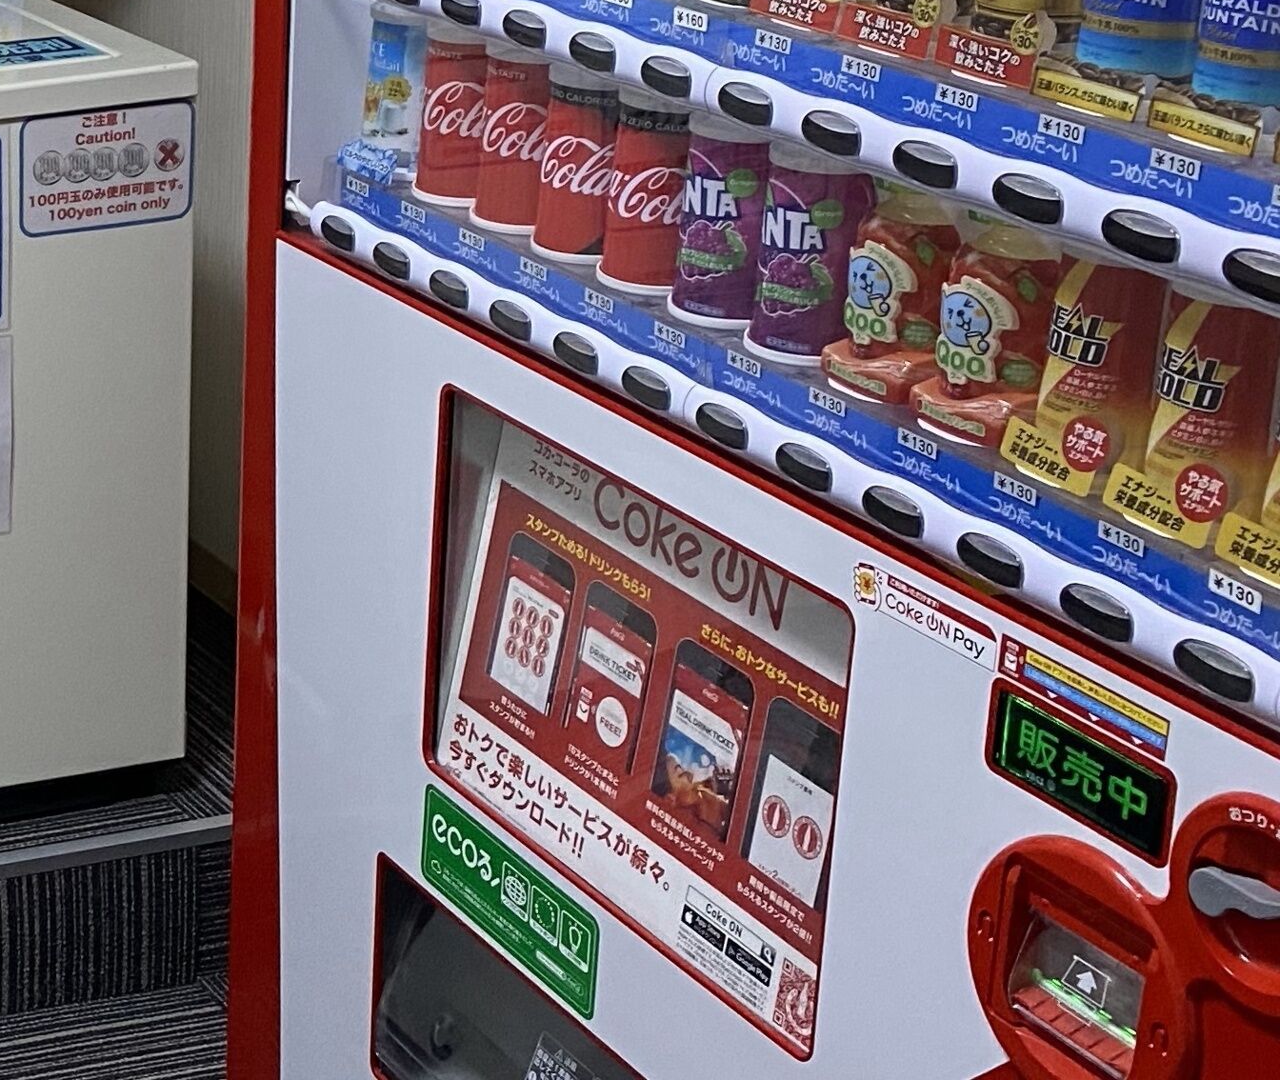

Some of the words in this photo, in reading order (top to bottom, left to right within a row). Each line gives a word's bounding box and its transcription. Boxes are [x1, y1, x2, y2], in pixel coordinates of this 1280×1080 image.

[758, 32, 789, 51] ¥130
[859, 23, 907, 51] 飲みごたえ
[955, 51, 1006, 78] 飲みごたえ
[76, 128, 135, 145] Caution!
[1043, 117, 1081, 141] ¥130
[49, 206, 103, 221] 100yen
[107, 204, 137, 214] coin
[142, 197, 170, 212] only
[404, 203, 424, 221] ¥130
[587, 291, 611, 310] ¥130
[529, 459, 583, 502] スマホアプリ
[997, 476, 1033, 502] ¥130
[1179, 484, 1222, 509] サポート
[593, 476, 704, 578] Coke
[885, 593, 923, 625] Coke
[953, 627, 985, 660] Pay
[1017, 721, 1148, 820] 販売中
[706, 903, 727, 927] Coke
[729, 922, 743, 939] ON
